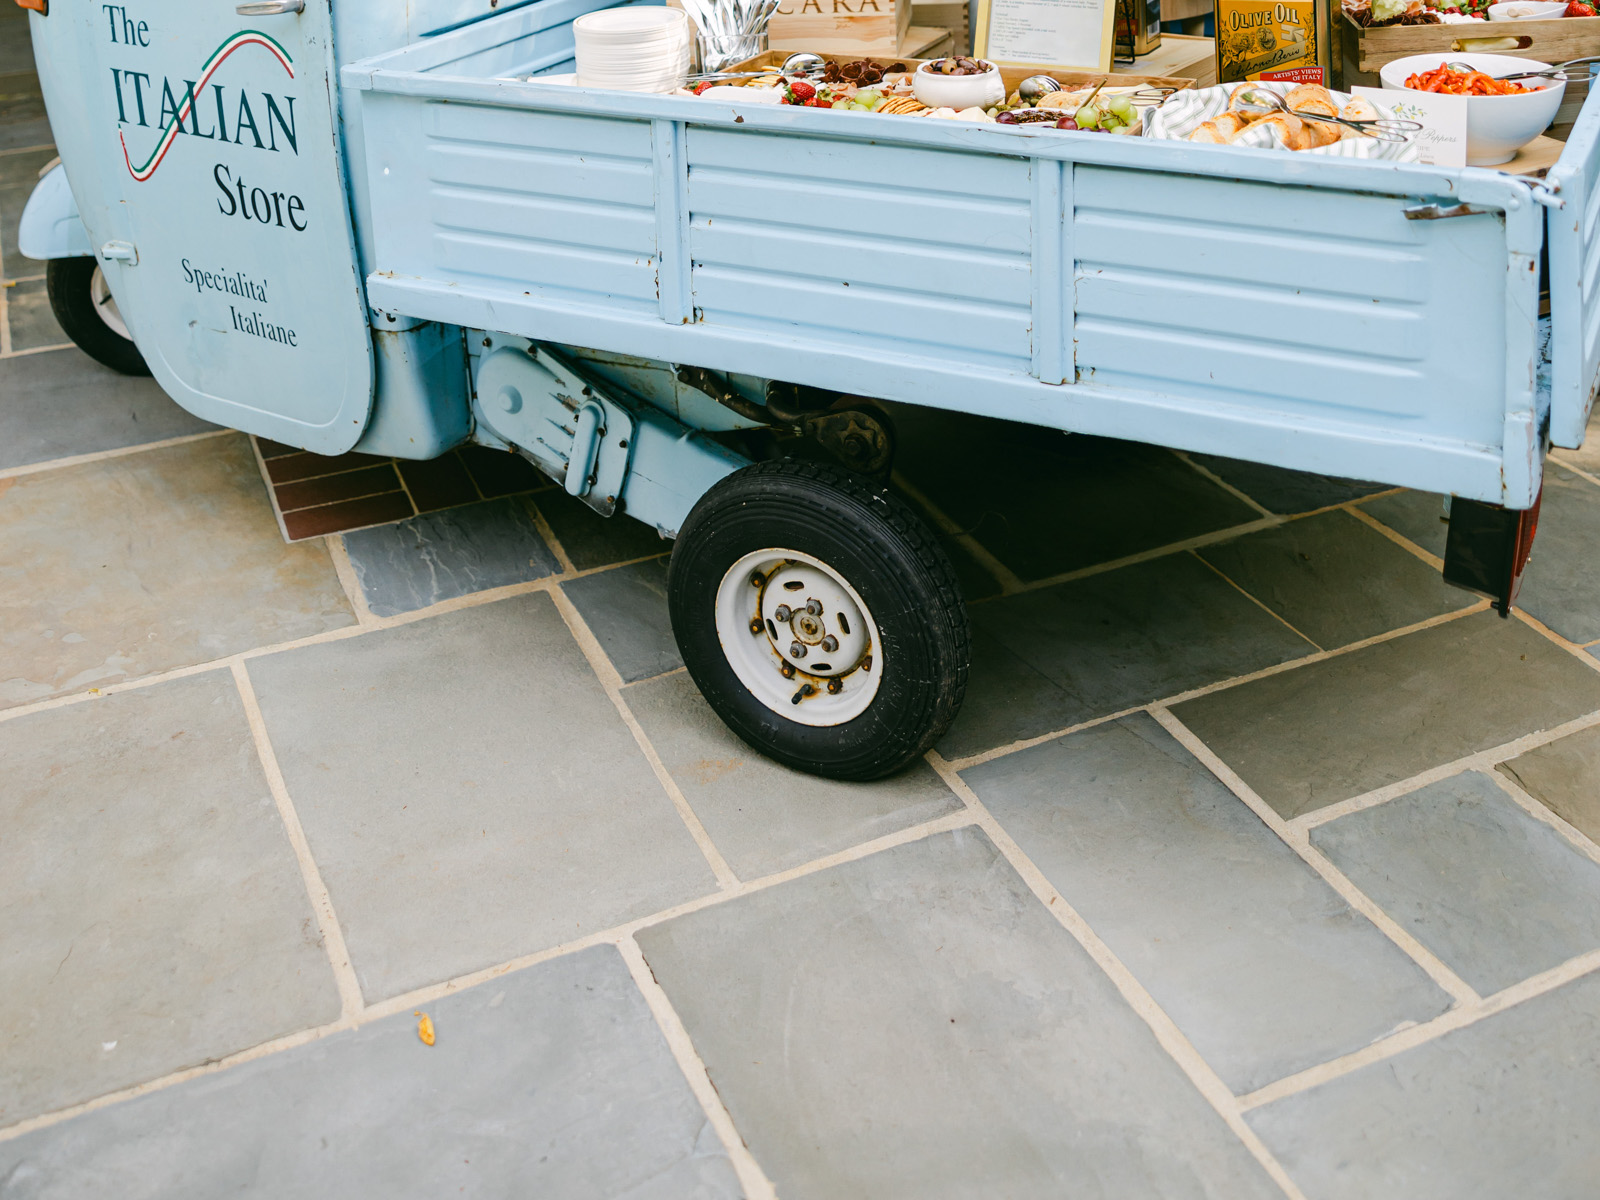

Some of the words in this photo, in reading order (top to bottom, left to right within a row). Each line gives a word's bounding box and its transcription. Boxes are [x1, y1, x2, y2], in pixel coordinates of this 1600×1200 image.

[102, 4, 150, 48] The
[1229, 10, 1272, 31] OLIVE
[1274, 3, 1299, 24] OIL
[109, 67, 299, 156] ITALIAN
[213, 163, 308, 232] Store
[181, 258, 268, 303] Specialita'
[229, 305, 298, 347] Italiane
